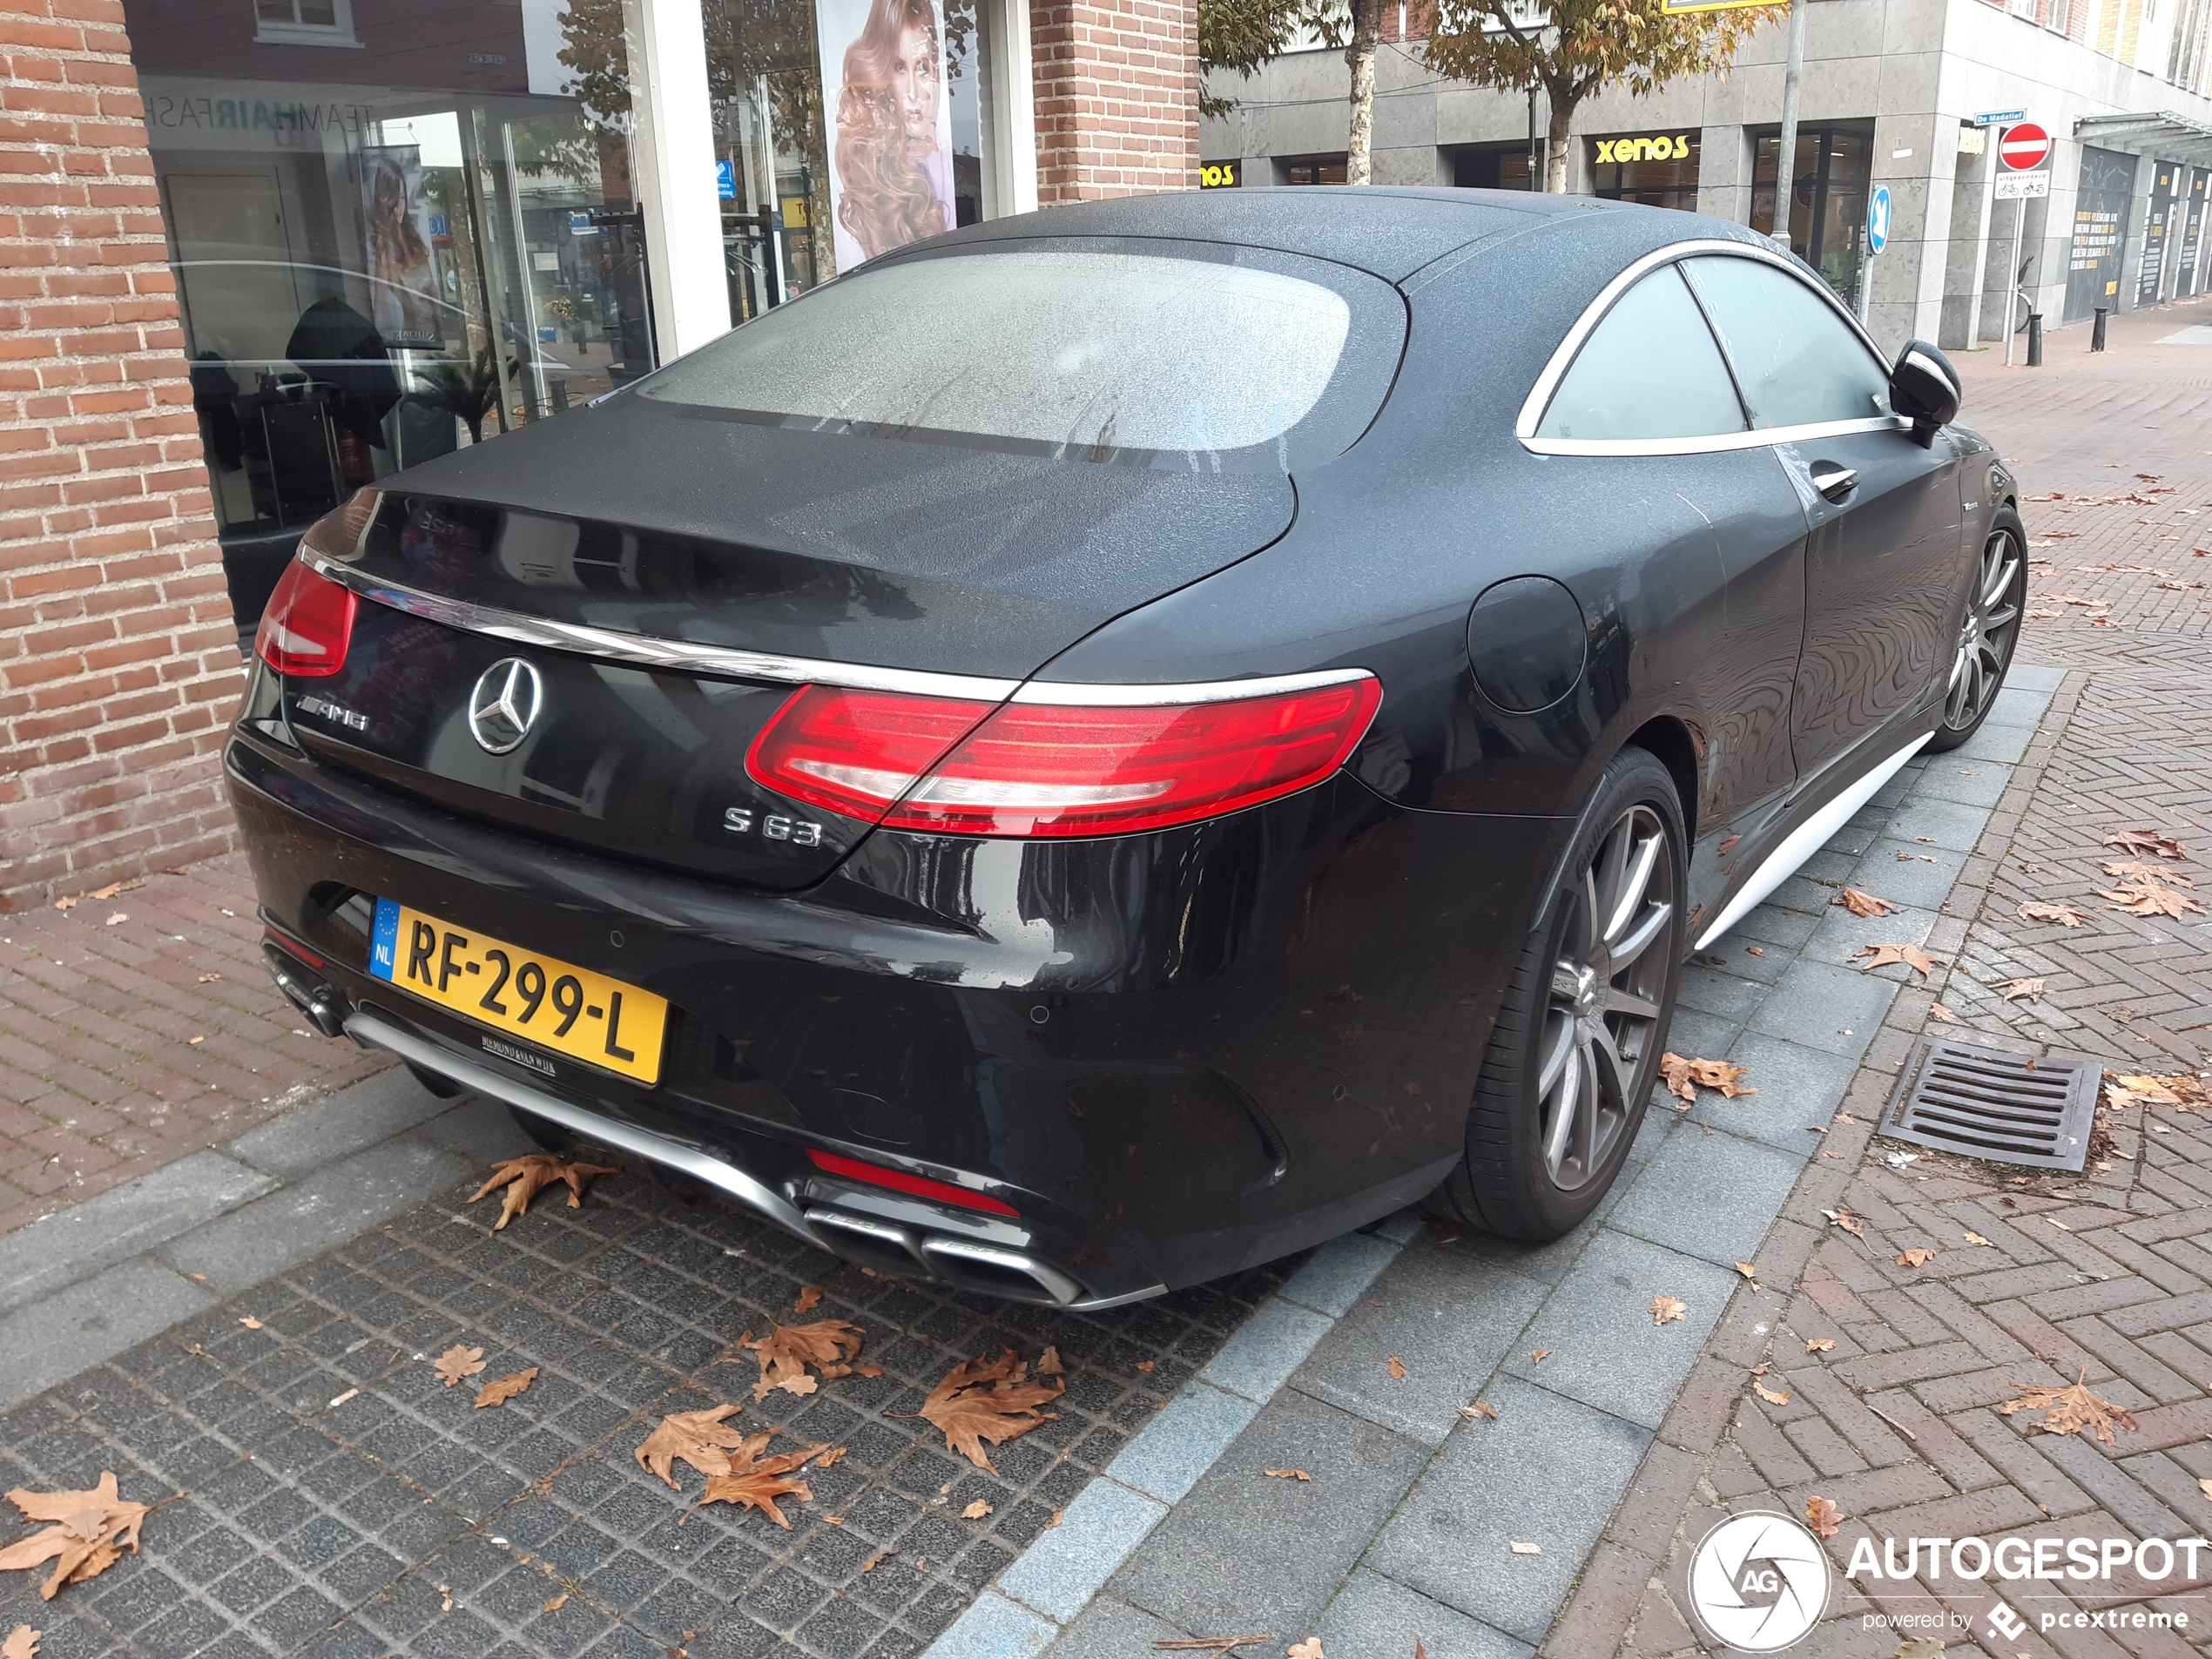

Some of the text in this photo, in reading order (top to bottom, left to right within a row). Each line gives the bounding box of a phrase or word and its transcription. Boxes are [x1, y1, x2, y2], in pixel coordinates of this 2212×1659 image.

[1989, 111, 2023, 122] Madelief
[1595, 135, 1689, 164] xenos
[1999, 173, 2047, 182] uitgezonderd
[723, 807, 821, 847] S 63
[375, 943, 391, 967] NL
[408, 920, 635, 1063] RF-299-L
